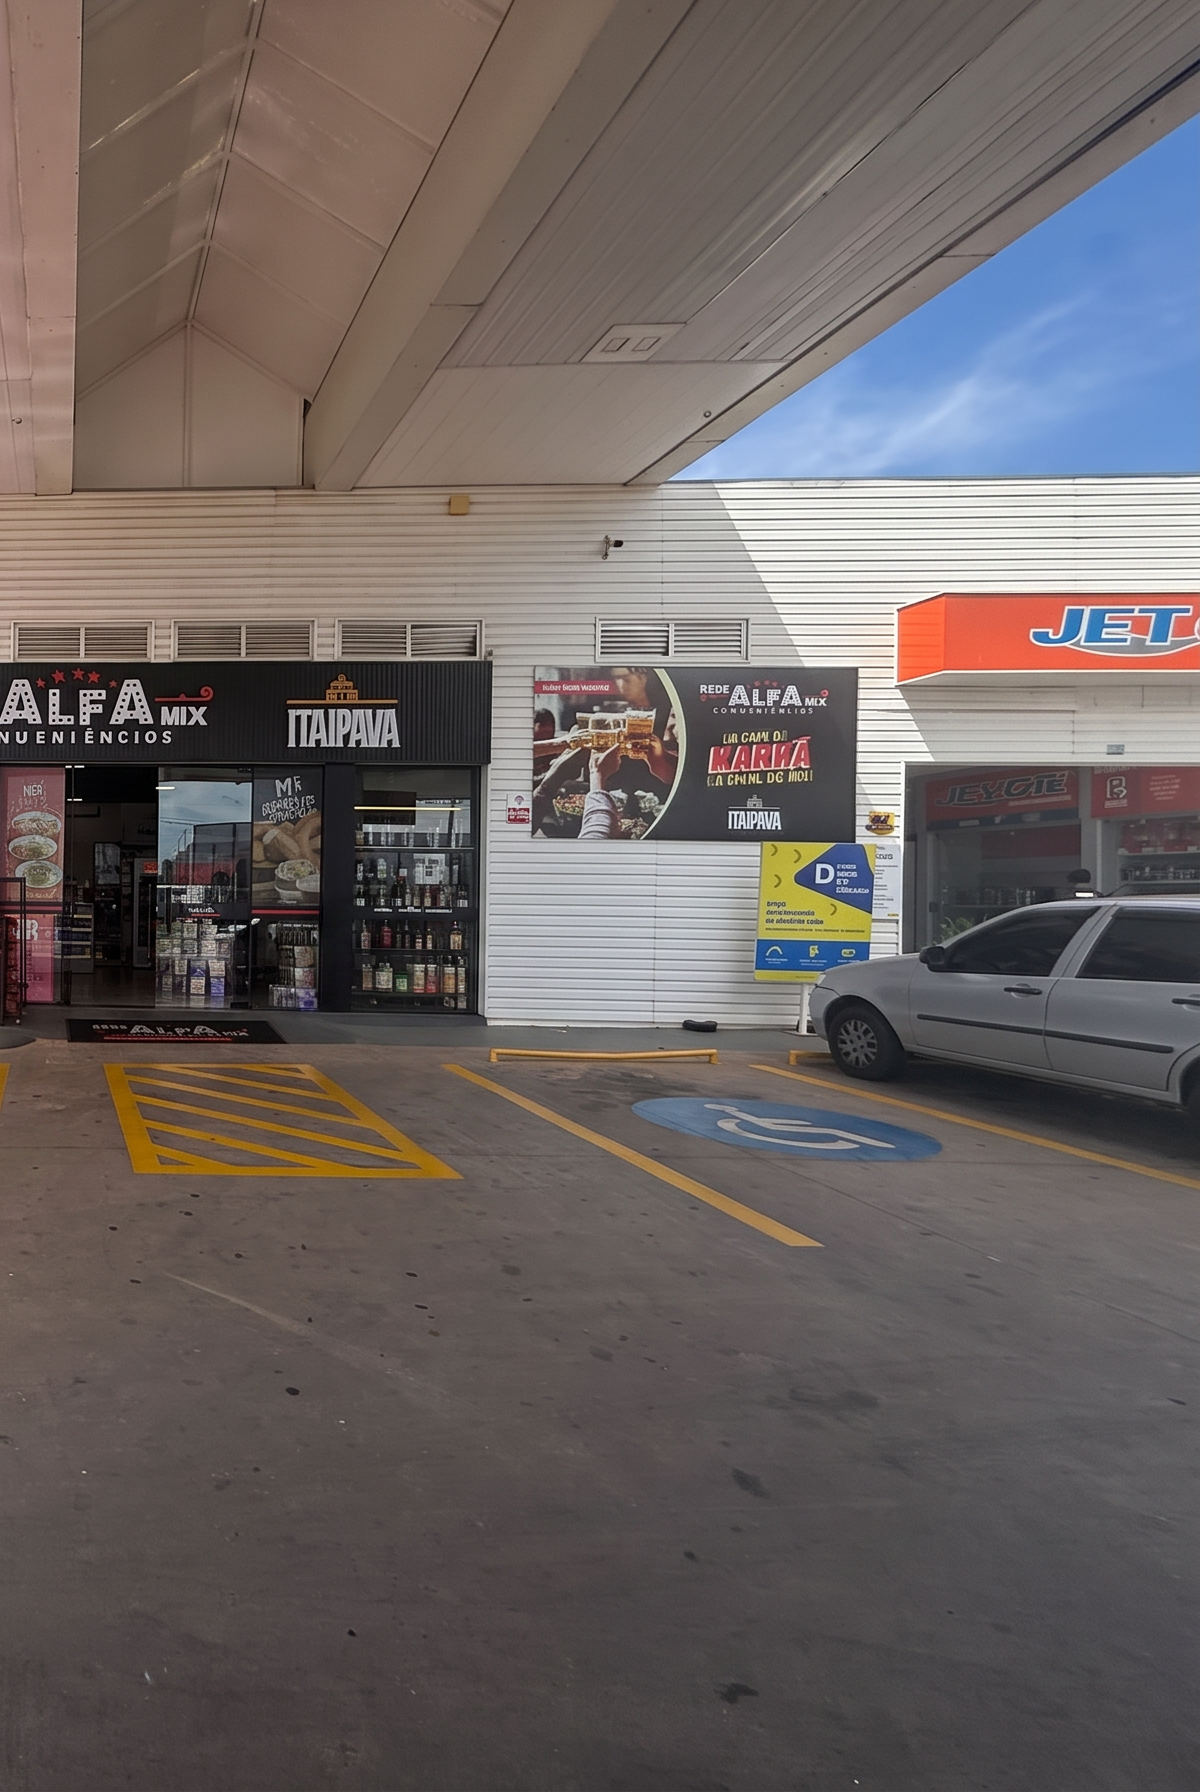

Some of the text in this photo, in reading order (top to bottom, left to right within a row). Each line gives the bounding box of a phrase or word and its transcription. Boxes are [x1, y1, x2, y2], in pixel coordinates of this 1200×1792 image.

[1029, 605, 1193, 647] JET
[699, 684, 730, 694] REDE
[728, 684, 803, 706] ALFA
[160, 706, 208, 726] MIX
[286, 708, 401, 748] ITAIPAVA
[728, 810, 782, 830] ITAIPAVA
